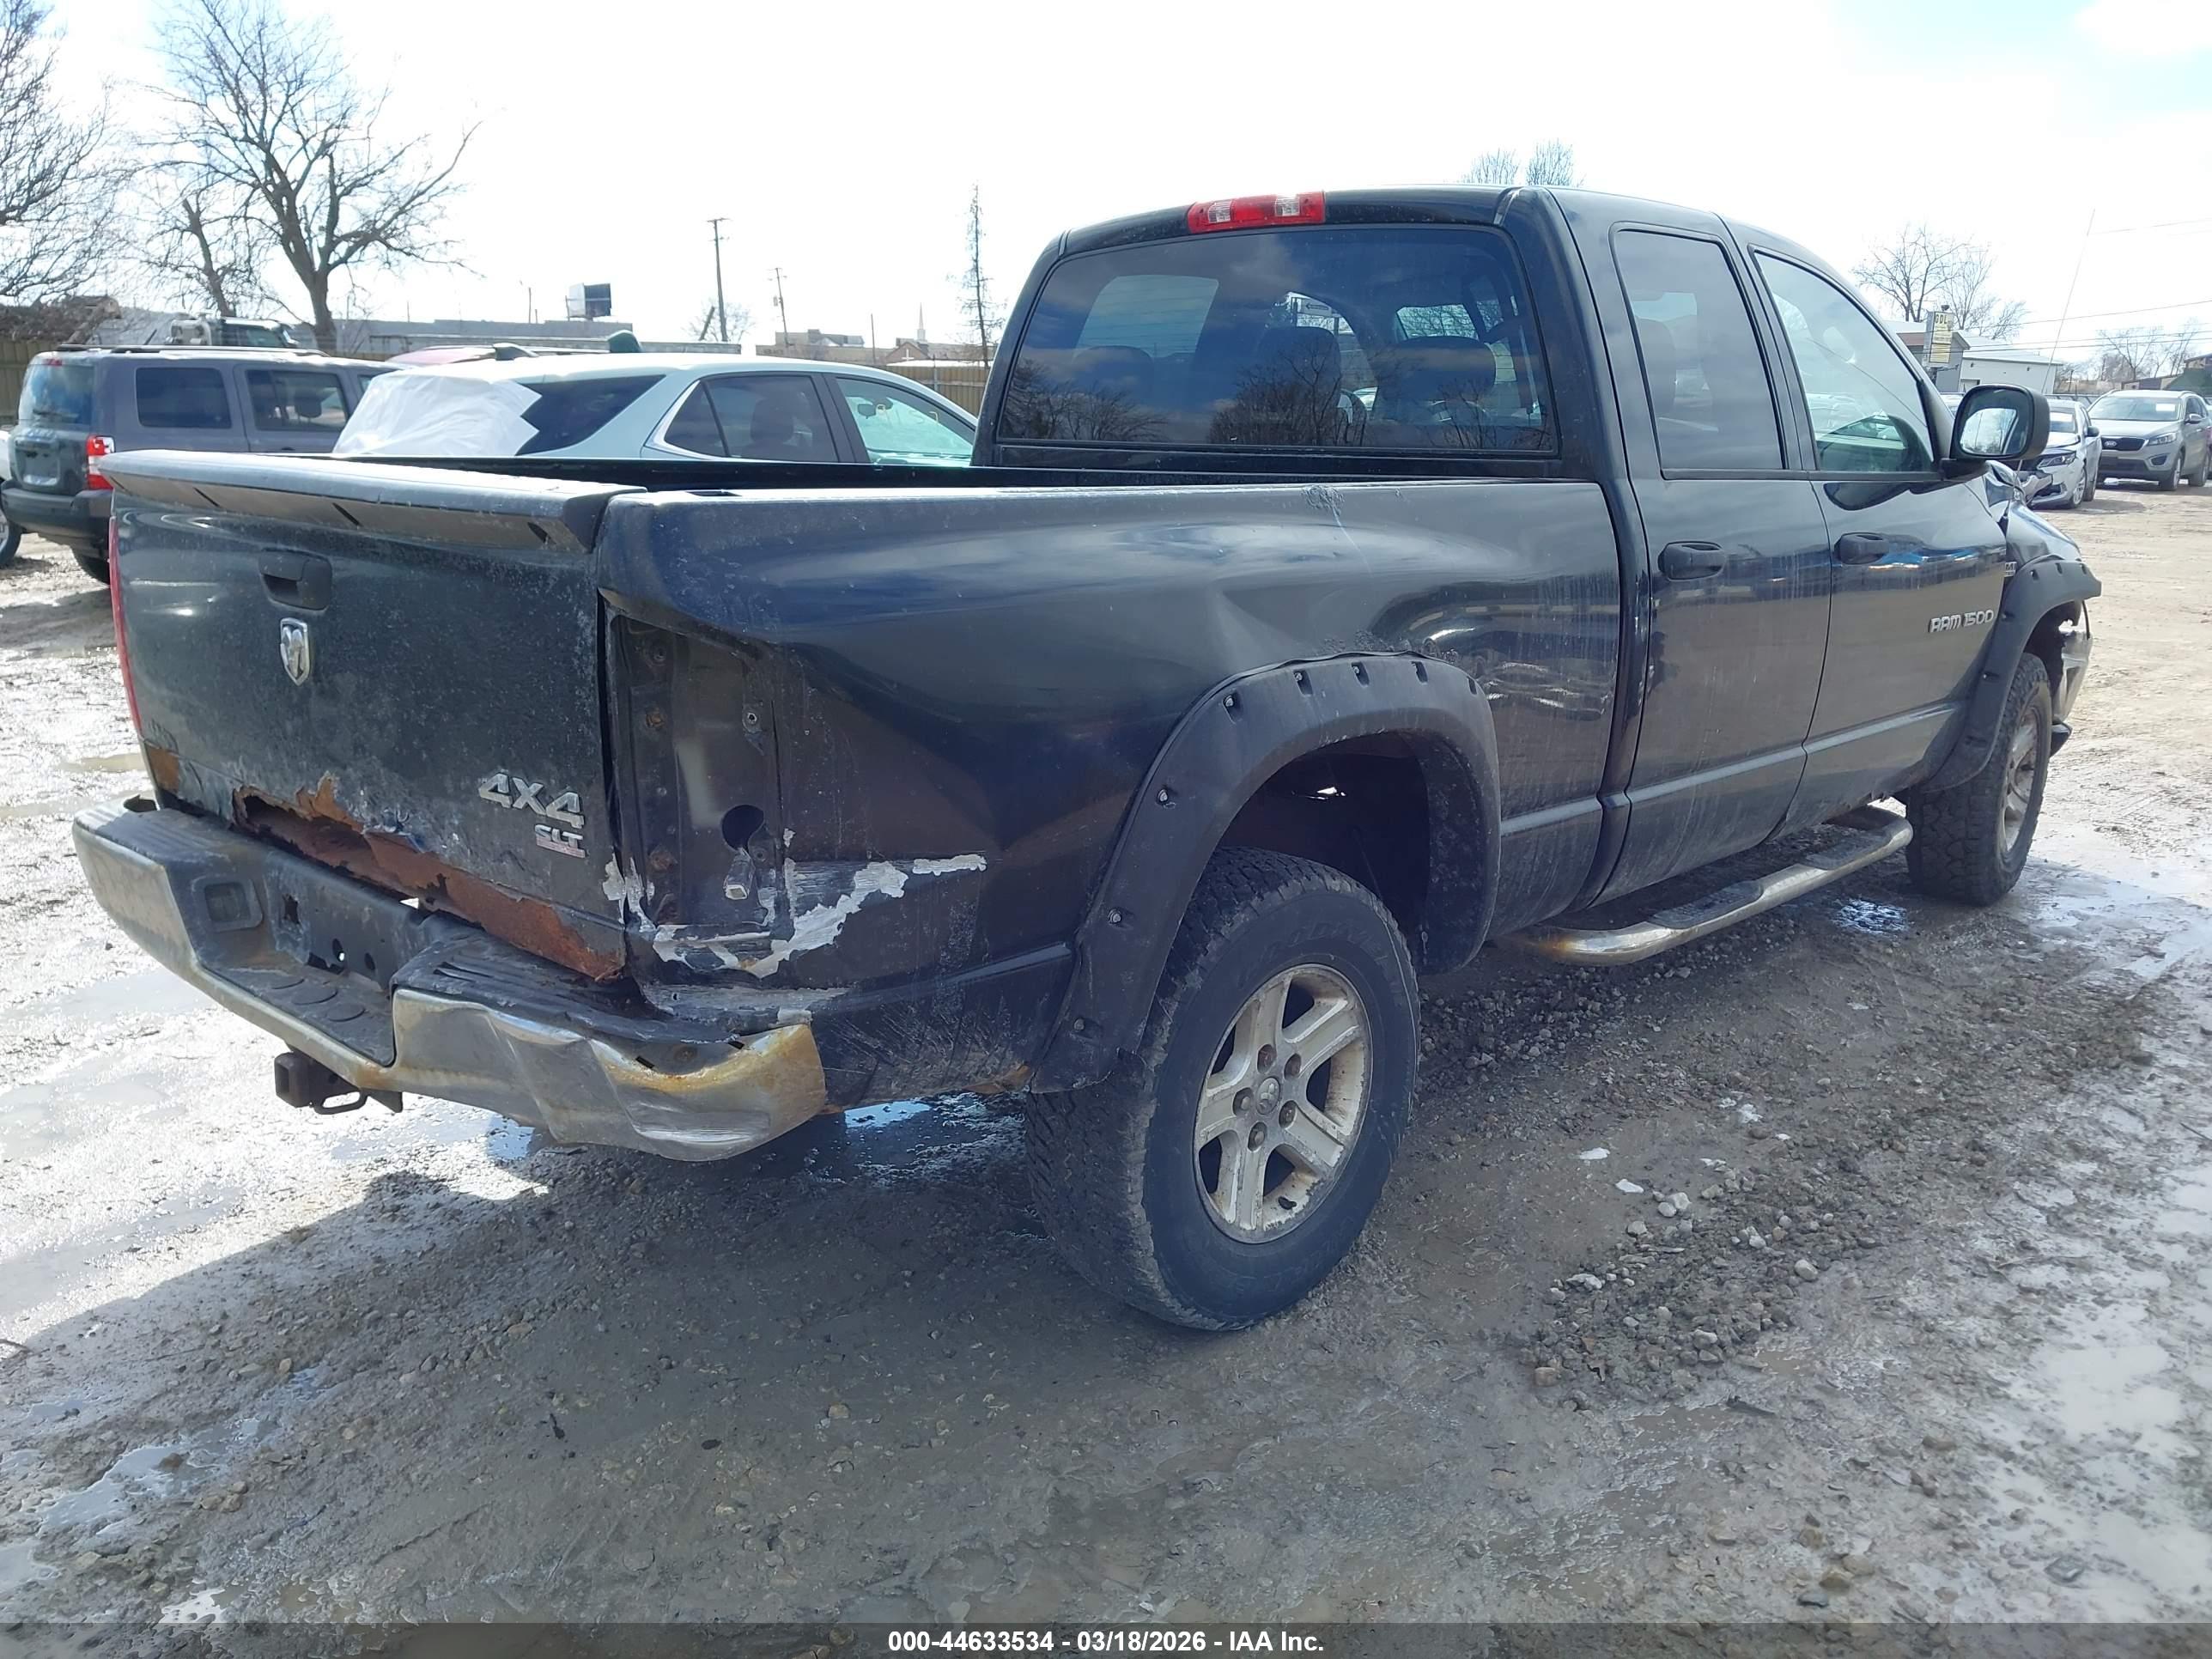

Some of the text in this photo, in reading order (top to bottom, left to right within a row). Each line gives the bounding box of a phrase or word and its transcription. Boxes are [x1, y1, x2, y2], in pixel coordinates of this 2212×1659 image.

[1931, 610, 1994, 632] RAM 1500
[535, 824, 585, 854] SLT
